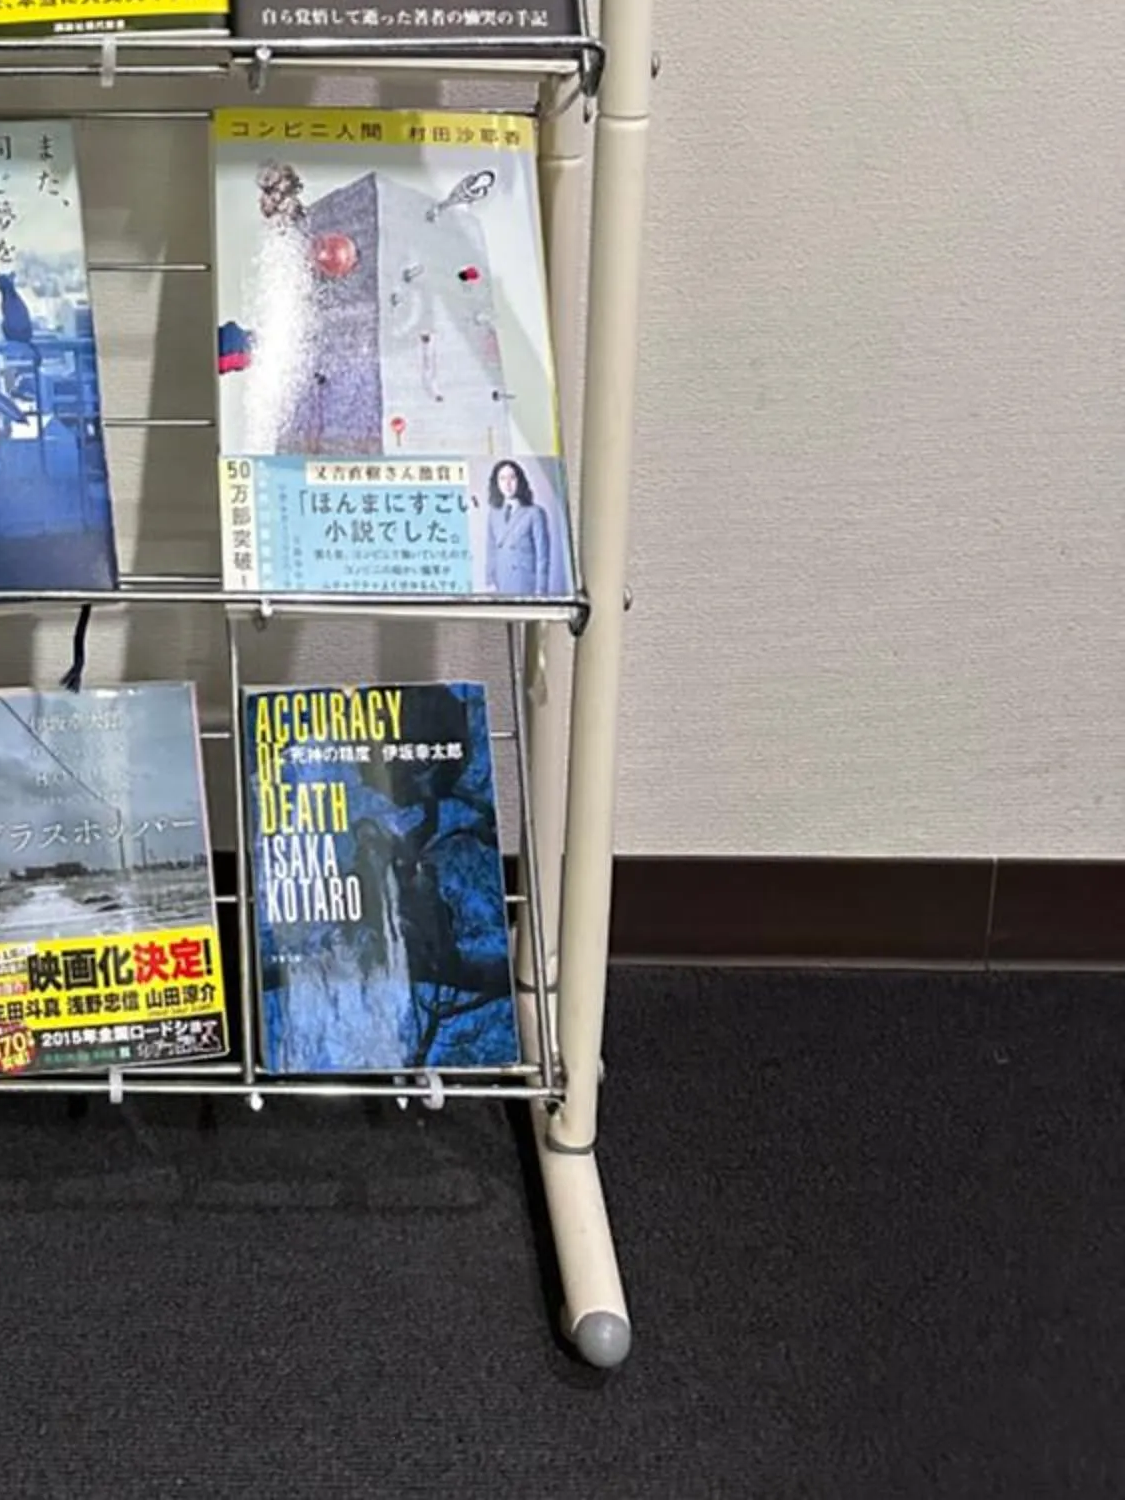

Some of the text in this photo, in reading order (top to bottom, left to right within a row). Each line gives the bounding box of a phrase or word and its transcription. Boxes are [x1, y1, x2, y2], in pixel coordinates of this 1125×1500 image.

[231, 121, 522, 146] コンビニ人間 村田沙耶香
[38, 135, 70, 207] また、
[298, 490, 480, 515] 「ほんまにすごい
[325, 520, 461, 544] 小説でした。
[256, 690, 402, 744] ACCURACY
[382, 742, 463, 762] 伊坂幸太郎
[259, 783, 349, 835] DEATH
[263, 834, 338, 880] ISAKA
[266, 875, 363, 924] KOTARO
[28, 938, 213, 992] 映画化決定!
[67, 990, 140, 1016] 浅野忠信
